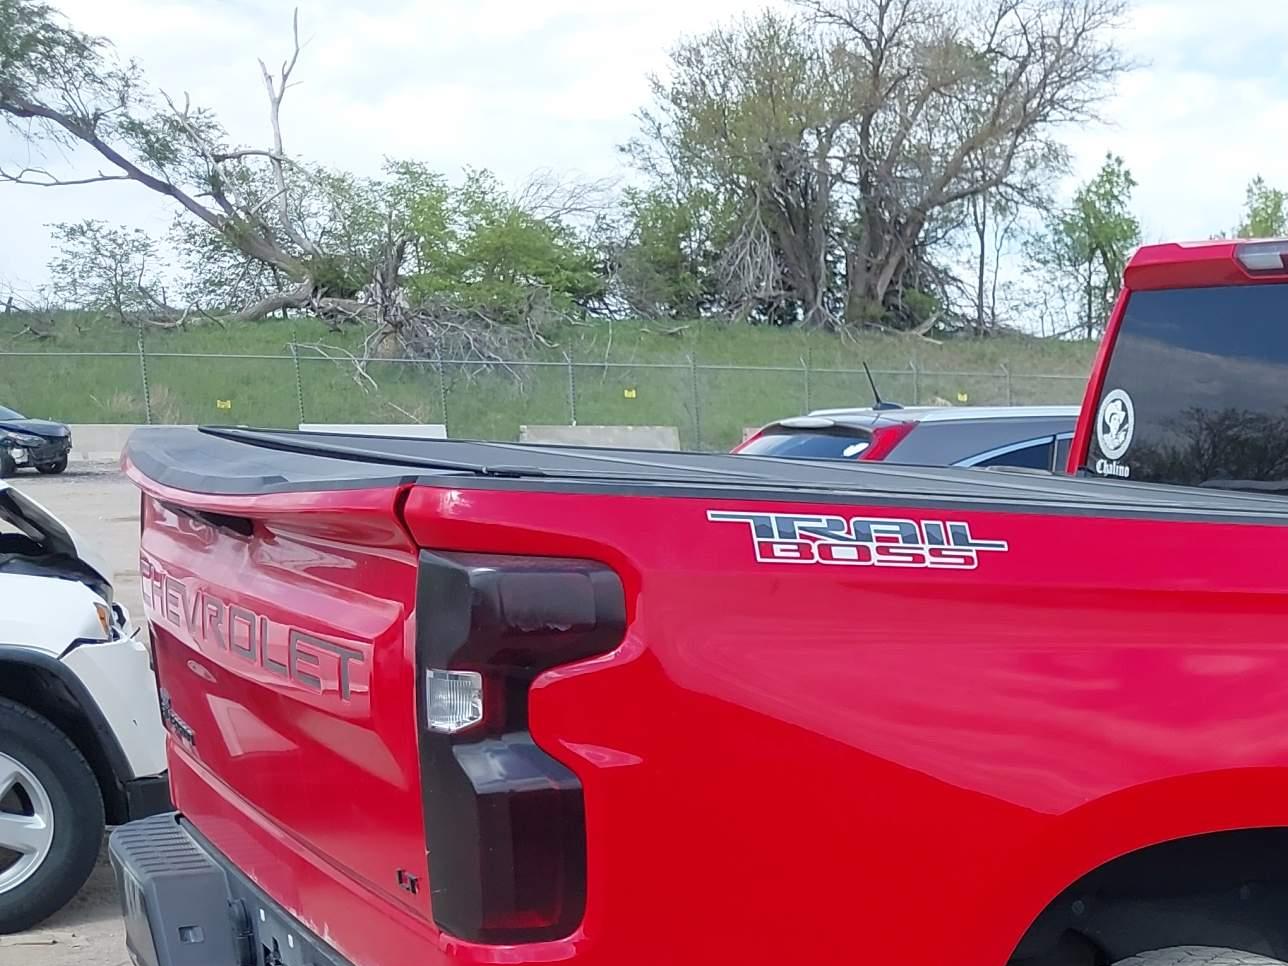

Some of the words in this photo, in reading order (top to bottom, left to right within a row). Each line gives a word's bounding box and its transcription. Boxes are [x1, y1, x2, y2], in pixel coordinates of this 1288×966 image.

[1096, 459, 1130, 477] Chalino
[706, 509, 1008, 551] TRAIL
[755, 539, 978, 569] BOSS
[139, 556, 365, 700] CHEVROLET
